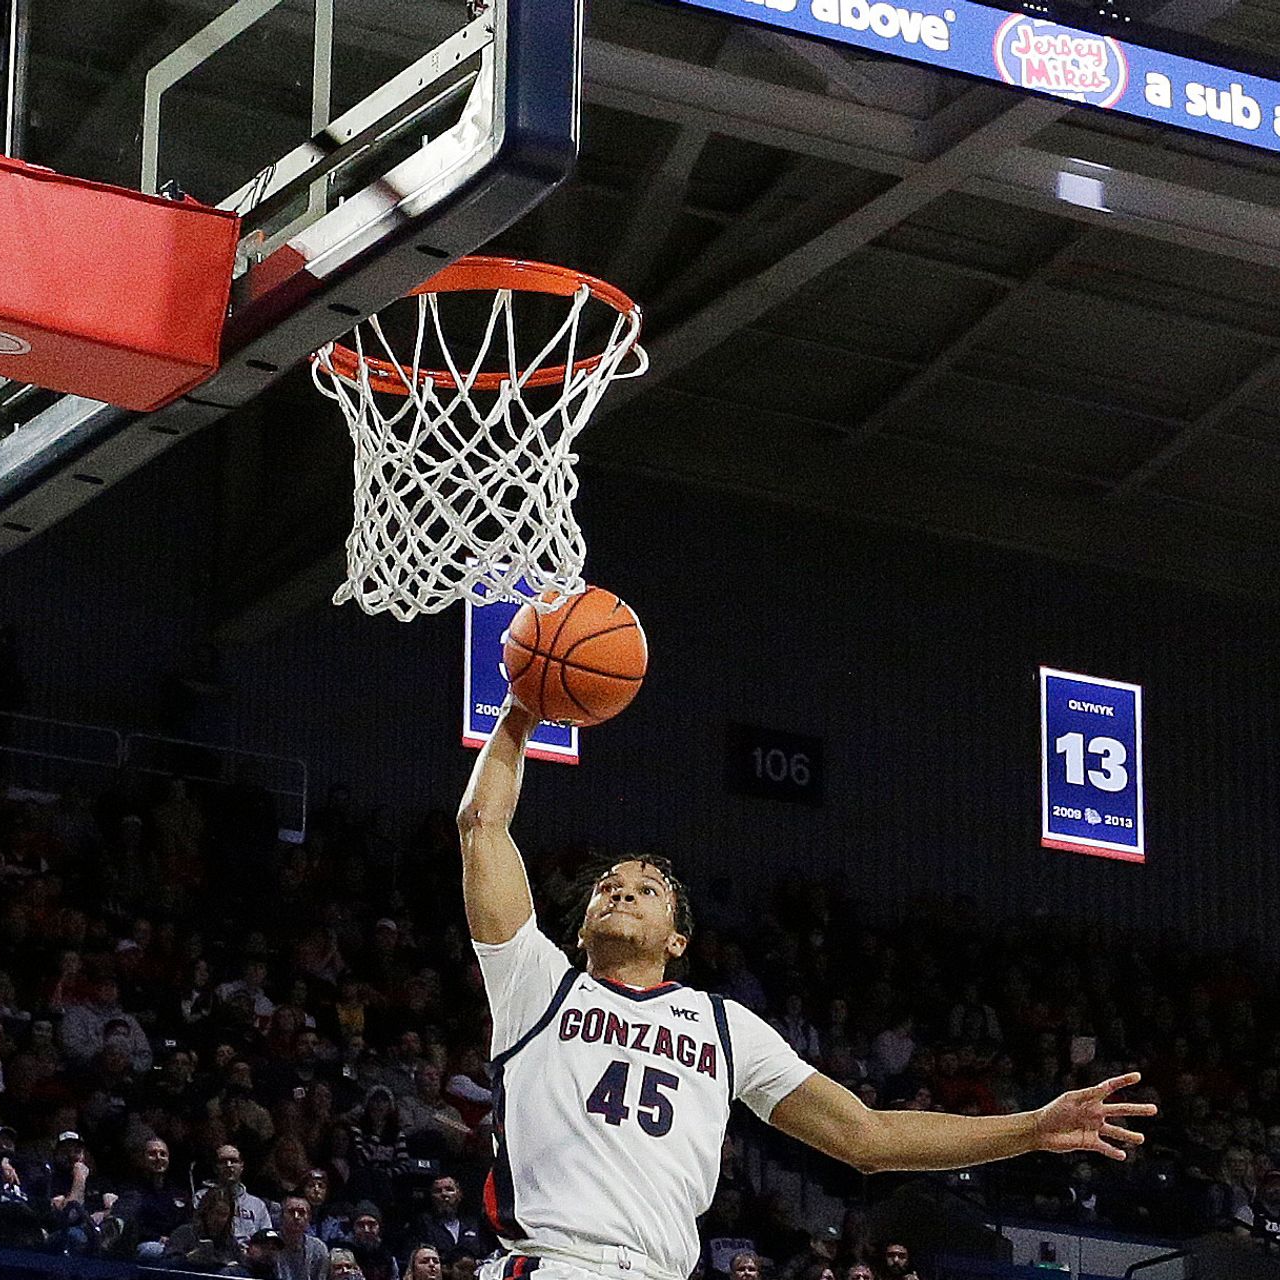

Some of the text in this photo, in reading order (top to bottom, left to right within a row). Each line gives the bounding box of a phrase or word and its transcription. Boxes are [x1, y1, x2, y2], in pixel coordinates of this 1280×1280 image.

[1011, 26, 1106, 66] Jersey
[1145, 71, 1172, 108] a
[1185, 83, 1261, 130] sub
[475, 703, 502, 716] 200
[1068, 699, 1115, 717] OLYNYK
[752, 746, 810, 786] 106
[1056, 732, 1128, 792] 13
[1053, 806, 1133, 829] 2009 2013
[559, 1008, 717, 1080] GONZAGA
[586, 1060, 679, 1137] 45
